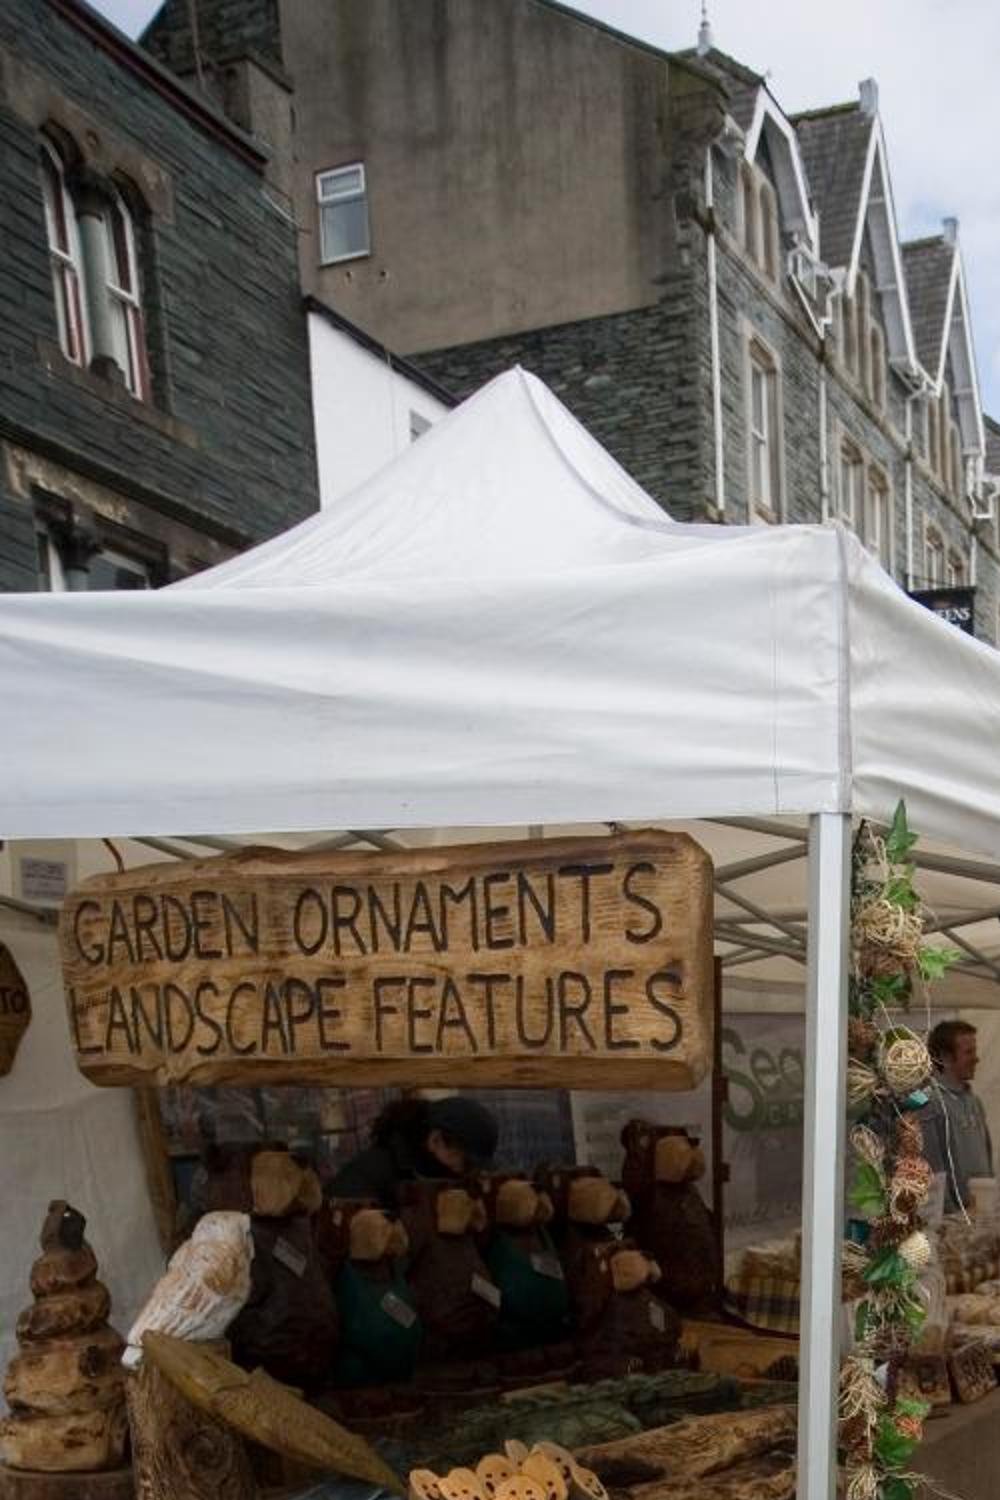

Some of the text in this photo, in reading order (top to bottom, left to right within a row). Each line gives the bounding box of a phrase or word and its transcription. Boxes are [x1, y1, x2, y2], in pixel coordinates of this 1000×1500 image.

[73, 862, 663, 968] GARDEN ORNAMENTS
[70, 969, 684, 1056] LANDSCAPE FEATURES
